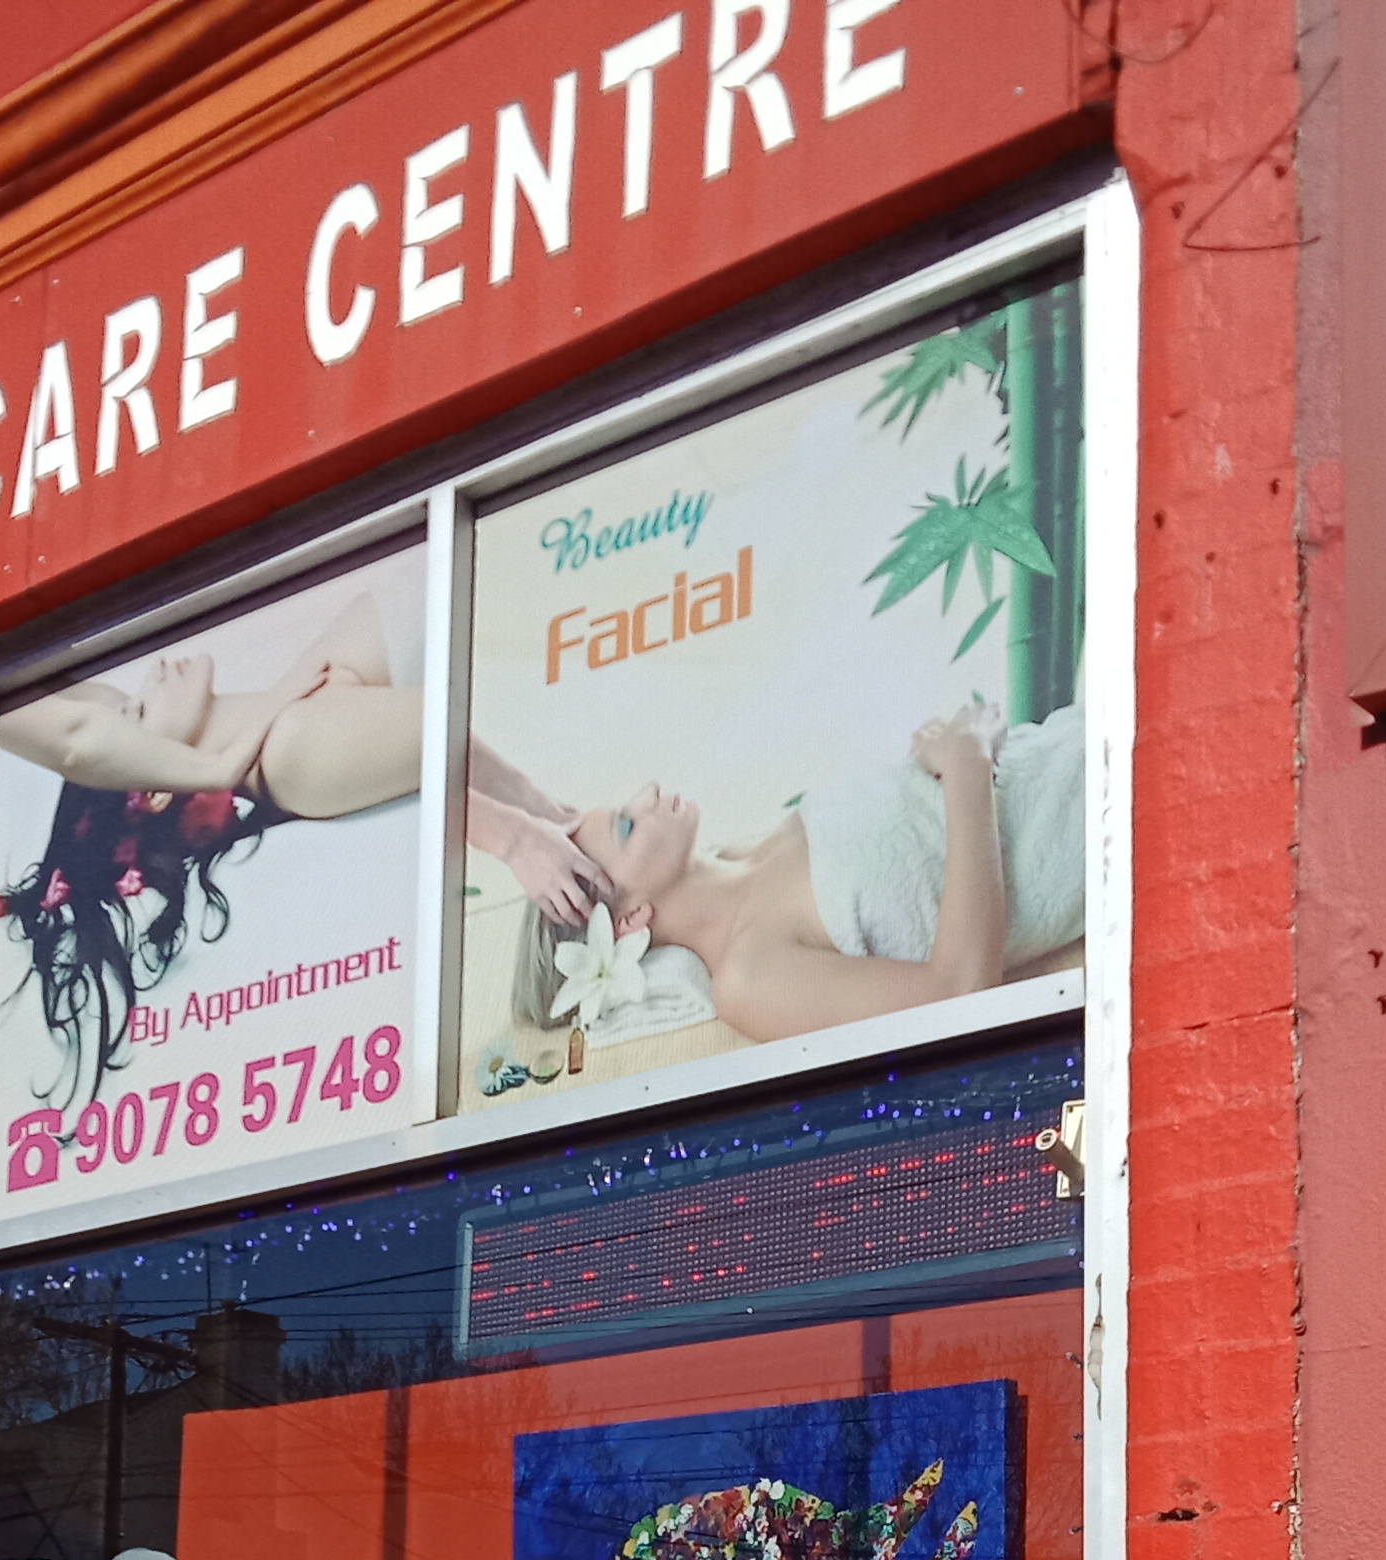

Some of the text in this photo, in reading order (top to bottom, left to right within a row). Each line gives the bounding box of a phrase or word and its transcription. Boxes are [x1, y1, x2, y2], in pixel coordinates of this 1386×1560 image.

[303, 0, 907, 366] CENTRE
[541, 489, 714, 574] Beauty
[546, 545, 754, 686] Facial
[128, 937, 403, 1047] By Appointment
[75, 1024, 403, 1175] 9078 5748
